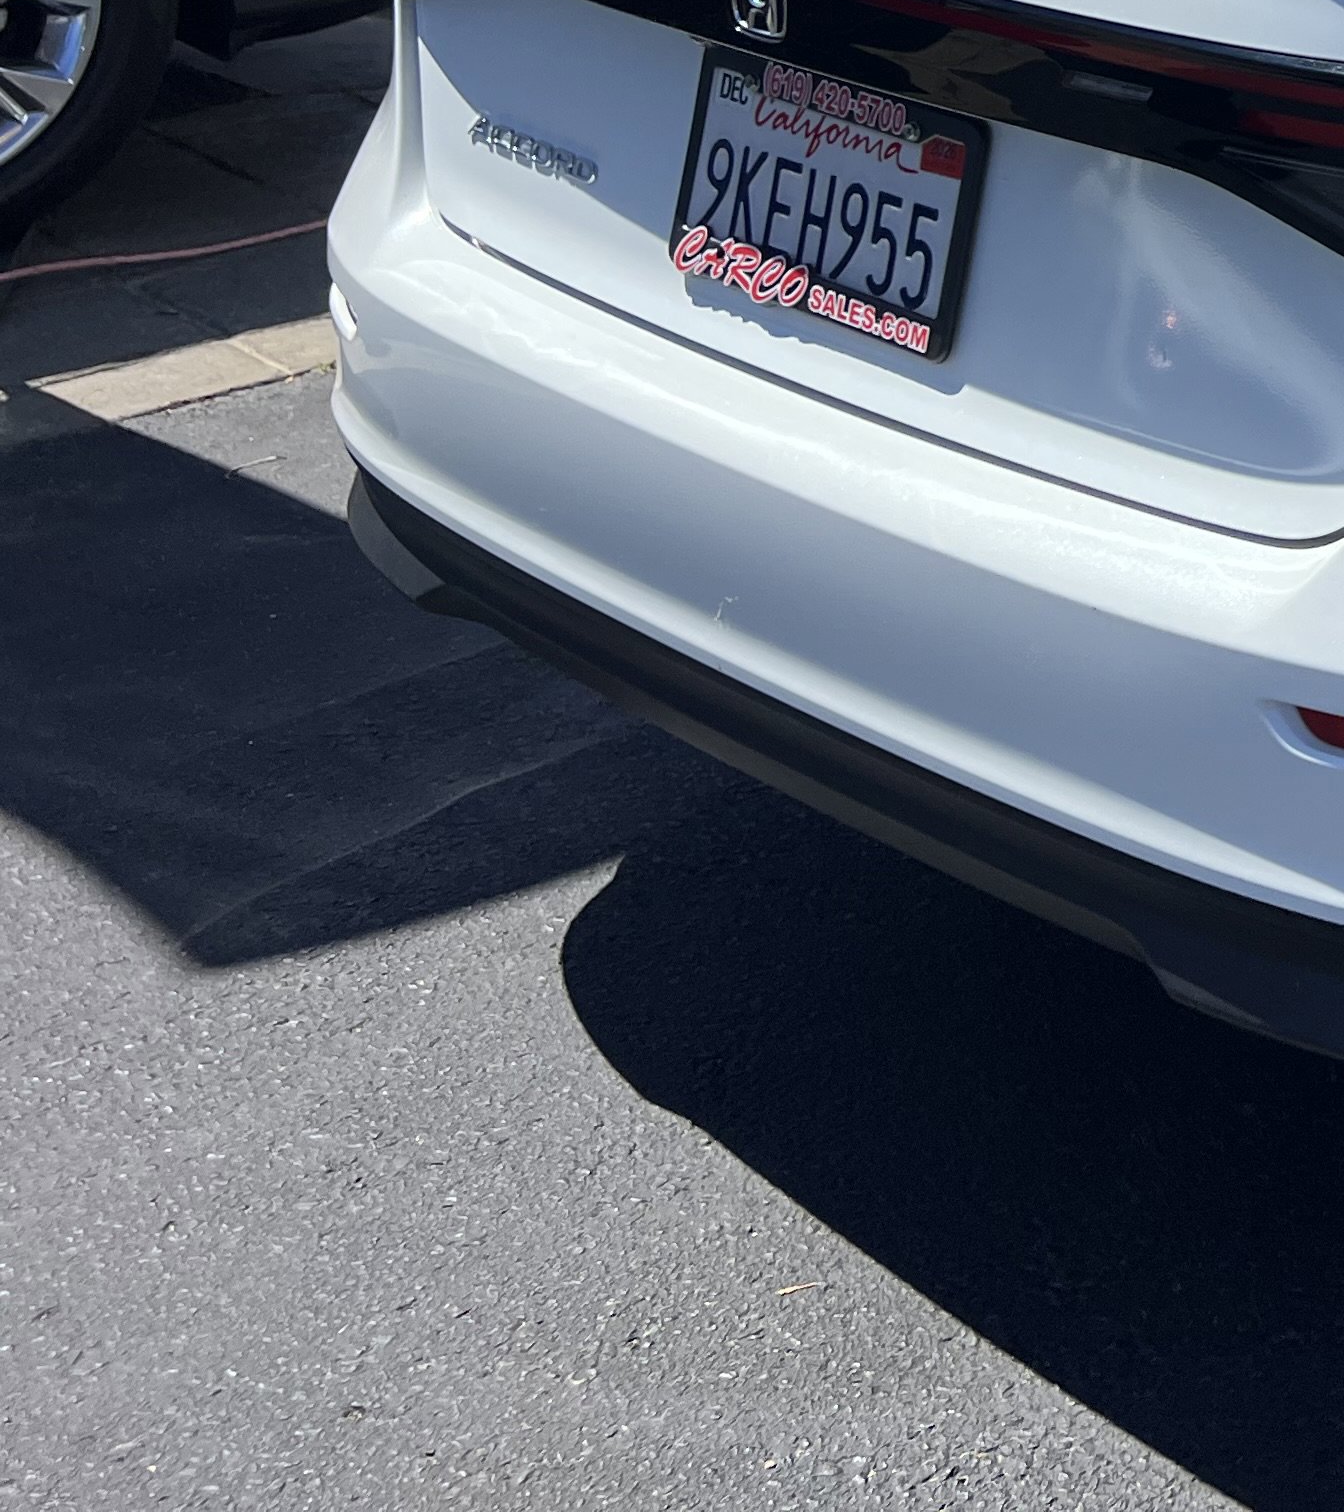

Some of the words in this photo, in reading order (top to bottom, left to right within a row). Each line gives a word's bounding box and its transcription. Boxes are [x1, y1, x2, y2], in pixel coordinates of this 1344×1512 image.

[720, 73, 748, 105] DEC
[764, 62, 813, 106] (619)
[754, 96, 919, 174] California
[686, 138, 940, 310] 9KEH955
[674, 225, 809, 307] CARCO
[808, 285, 930, 354] SALES.COM
